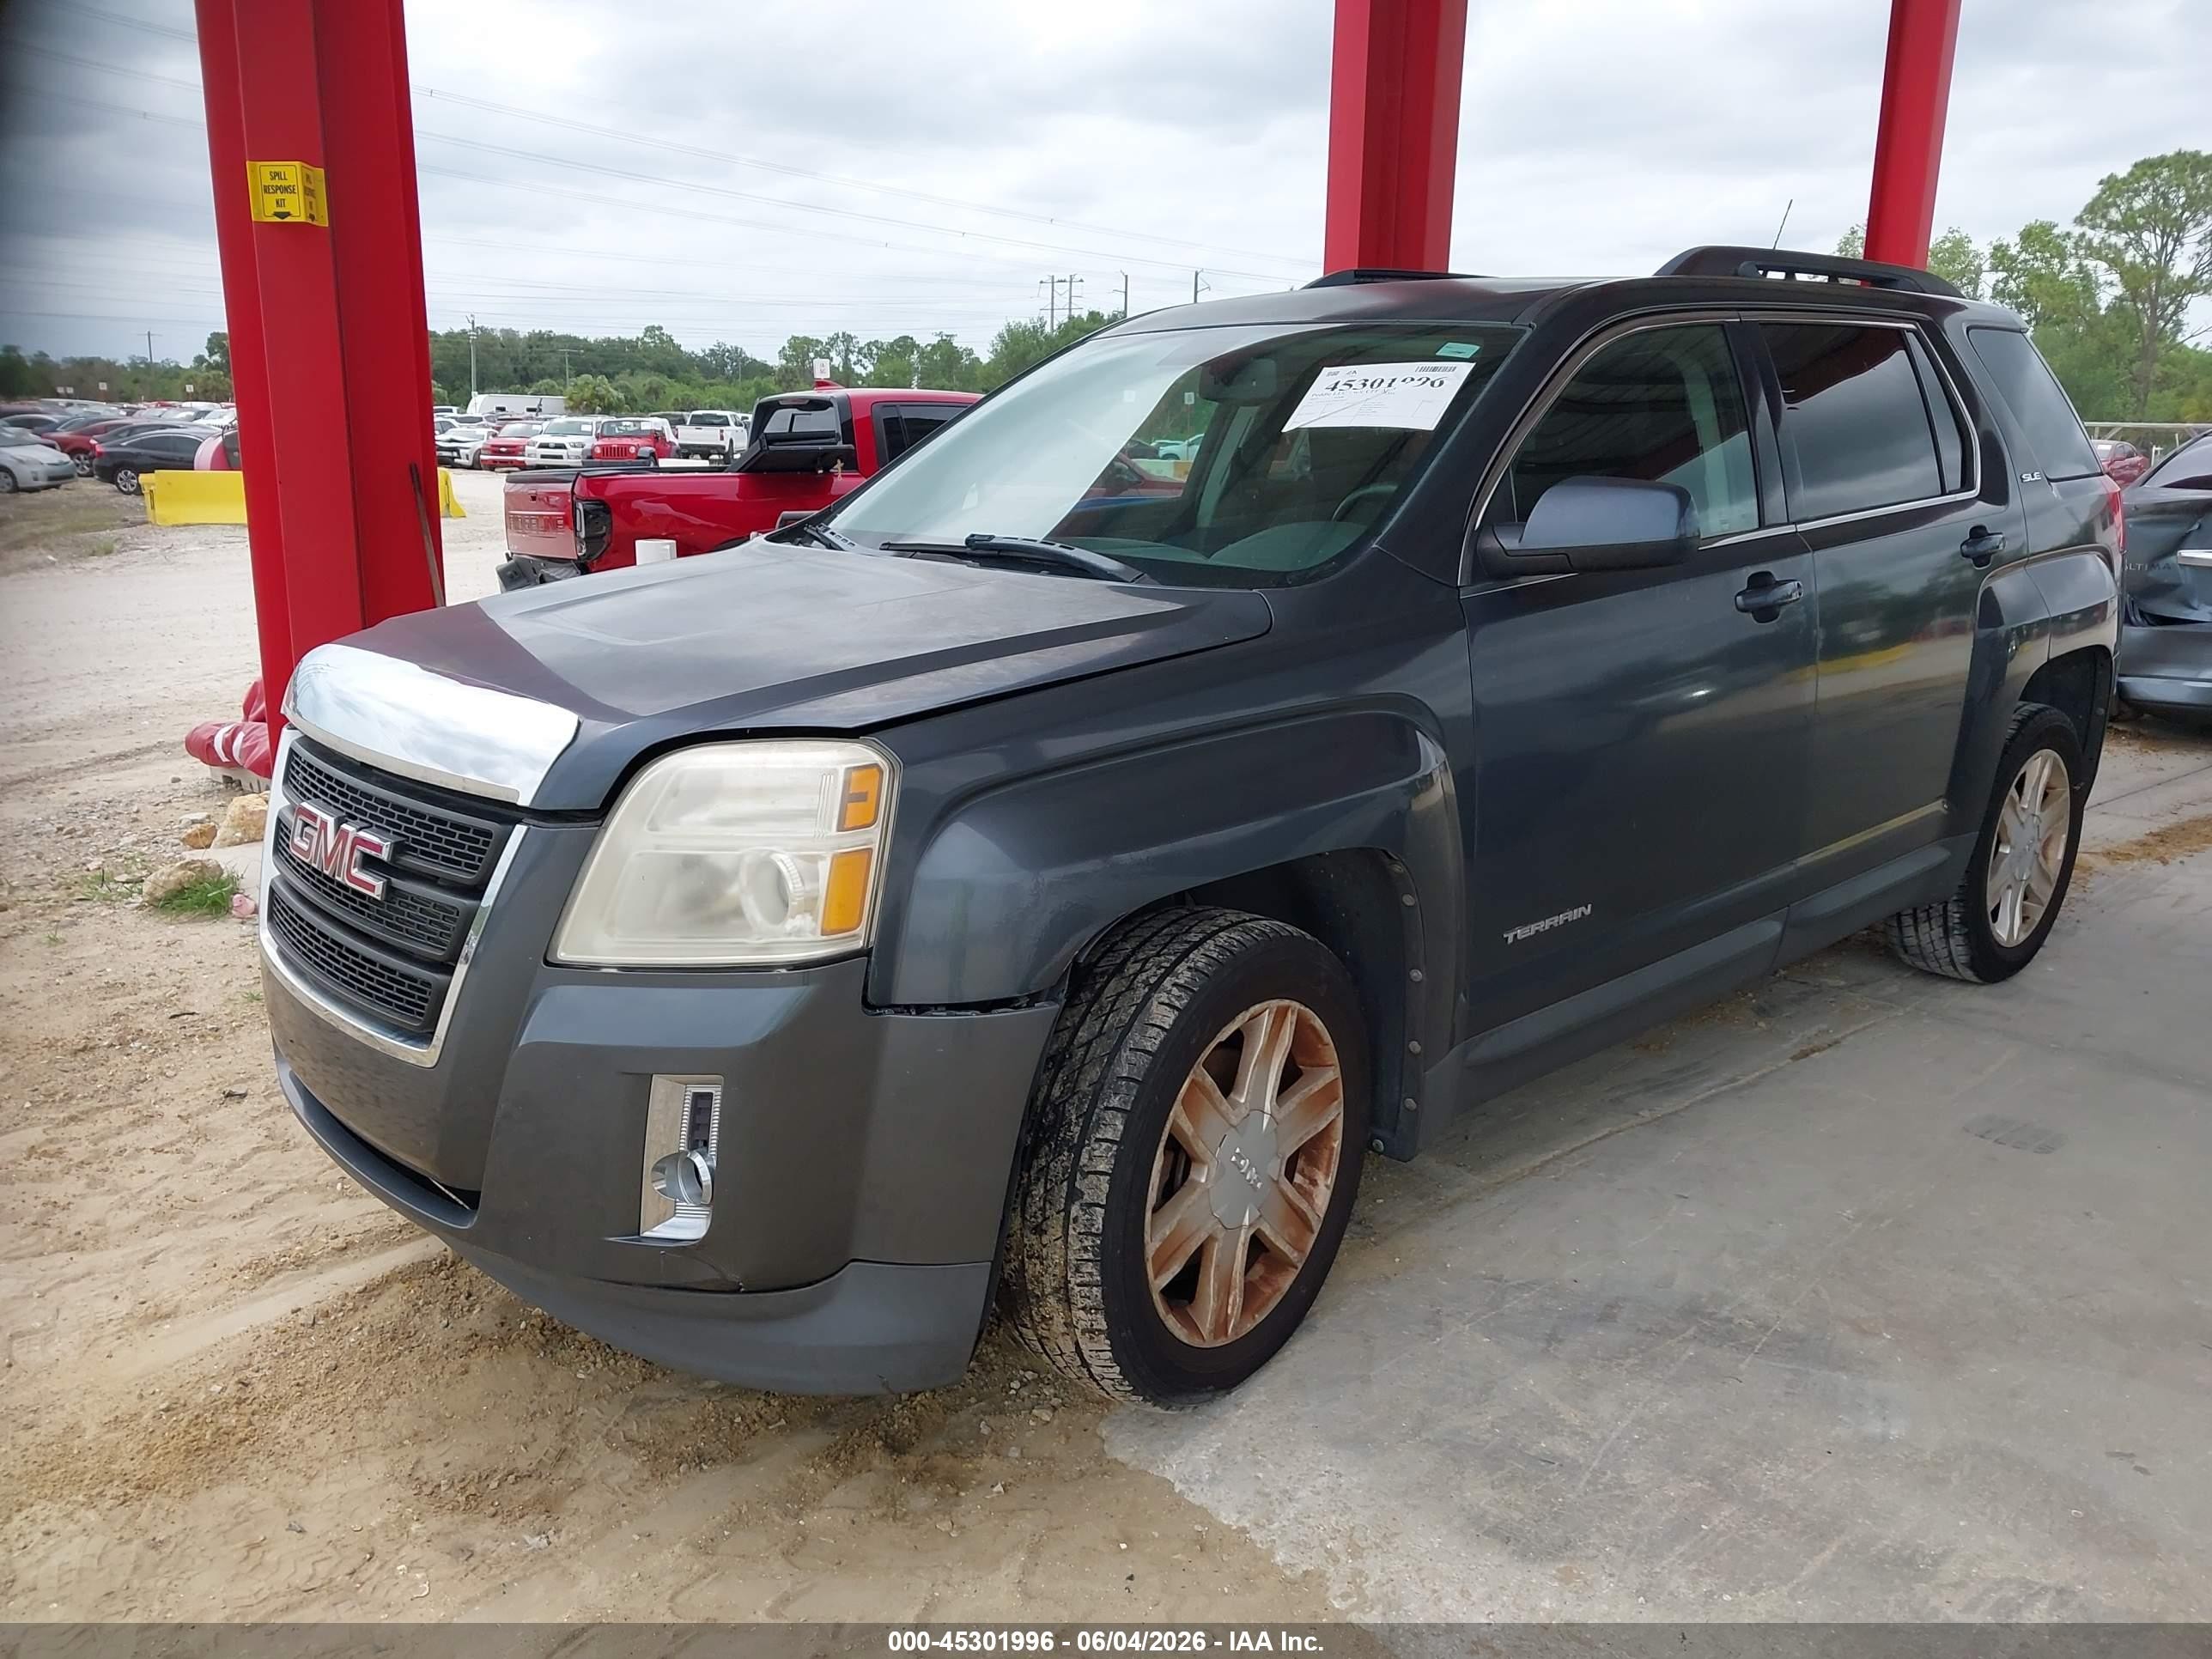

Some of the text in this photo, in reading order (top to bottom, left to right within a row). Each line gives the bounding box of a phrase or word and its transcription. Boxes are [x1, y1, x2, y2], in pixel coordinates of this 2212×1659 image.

[269, 171, 288, 181] SPILL
[263, 185, 296, 195] RESPONSE
[276, 198, 286, 208] KIT
[2021, 471, 2042, 483] SLE
[289, 801, 392, 901] GMC
[1503, 903, 1592, 945] TERRAIN
